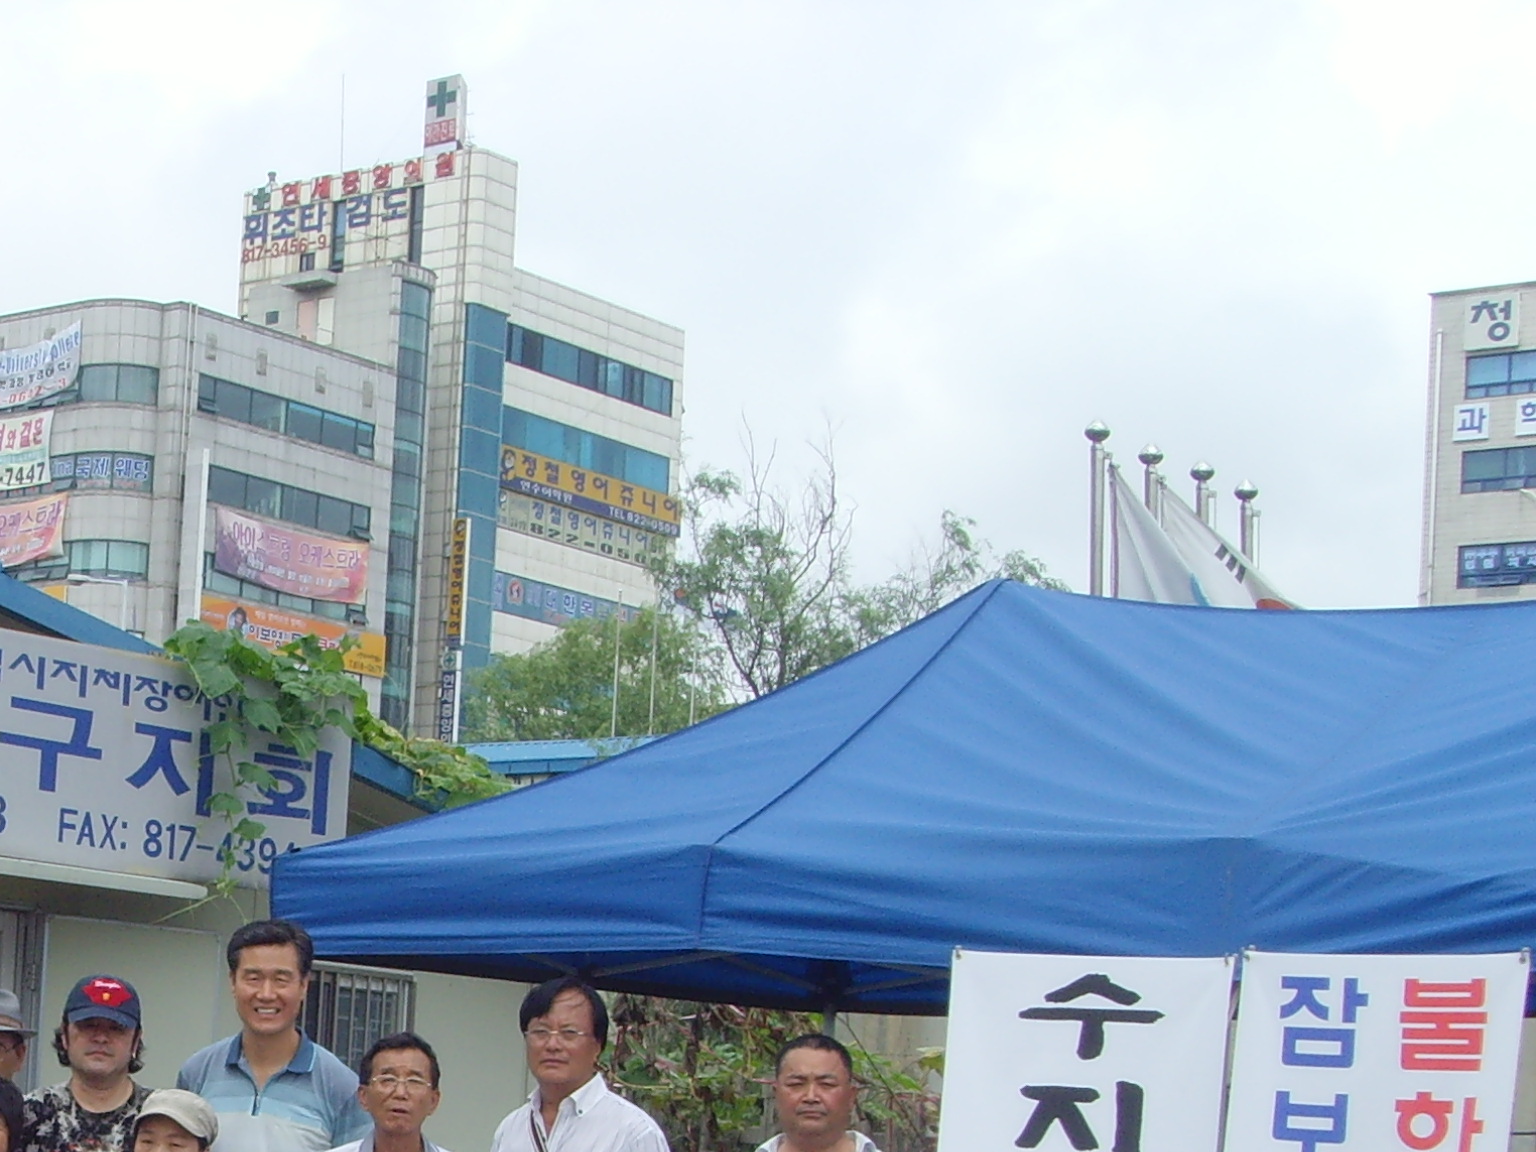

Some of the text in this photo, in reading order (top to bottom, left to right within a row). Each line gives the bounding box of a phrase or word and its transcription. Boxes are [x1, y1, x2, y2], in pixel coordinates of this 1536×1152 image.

[347, 188, 409, 228] 검도
[75, 457, 110, 480] 국제
[115, 456, 150, 480] 웨딩
[521, 454, 678, 522] 정철영어쥬니어
[609, 507, 626, 520] TEL
[57, 807, 129, 851] FAX:
